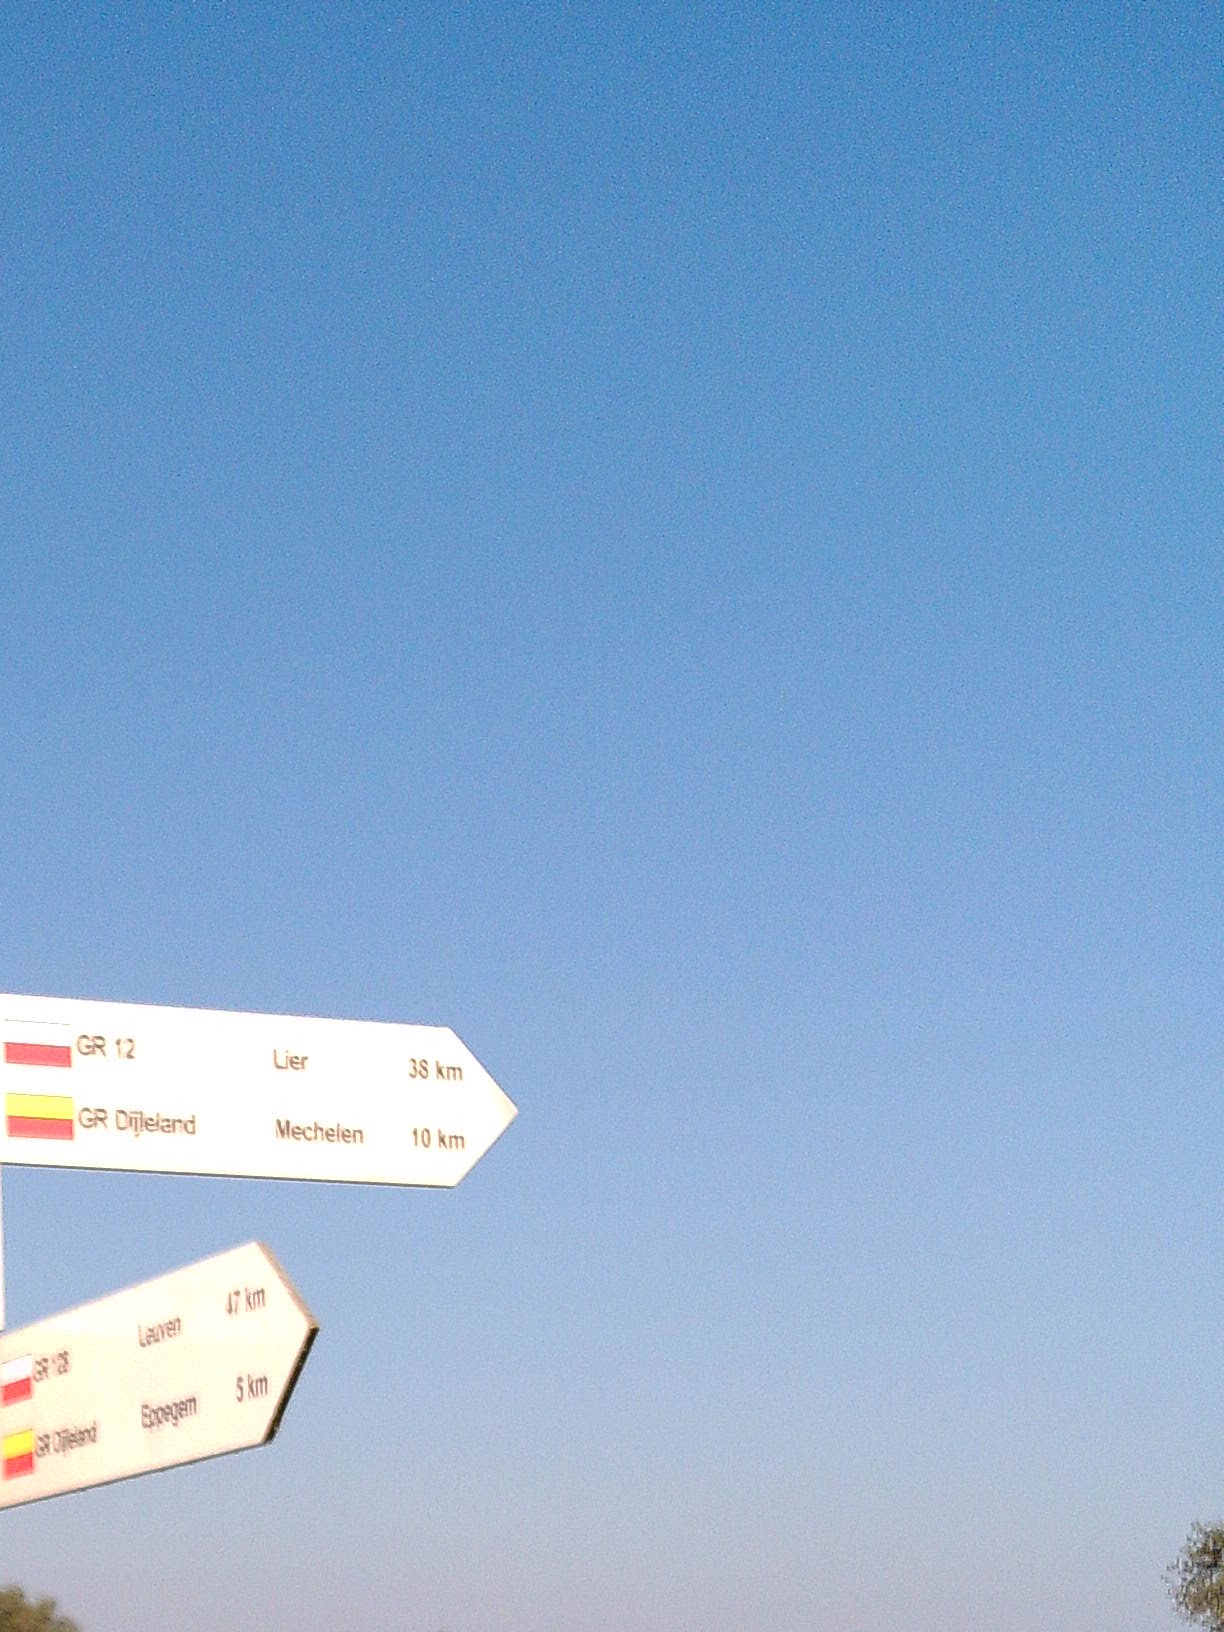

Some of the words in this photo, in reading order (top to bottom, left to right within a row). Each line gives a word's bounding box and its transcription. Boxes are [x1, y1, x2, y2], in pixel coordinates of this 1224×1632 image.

[77, 1034, 106, 1057] GR
[115, 1037, 136, 1060] 12
[272, 1049, 309, 1071] Lier
[408, 1058, 430, 1080] 38
[436, 1061, 464, 1082] km
[78, 1107, 108, 1130] GR
[116, 1110, 196, 1137] Dijleland
[275, 1119, 365, 1145] Mechelen
[411, 1128, 432, 1149] 10
[438, 1129, 466, 1151] km
[225, 1290, 241, 1316] 47
[244, 1287, 266, 1312] km
[138, 1316, 182, 1348] Leuven
[33, 1357, 50, 1382] GR
[235, 1378, 245, 1403] 5
[247, 1373, 268, 1399] km
[141, 1395, 198, 1429] Eppegem
[35, 1433, 52, 1459] GR
